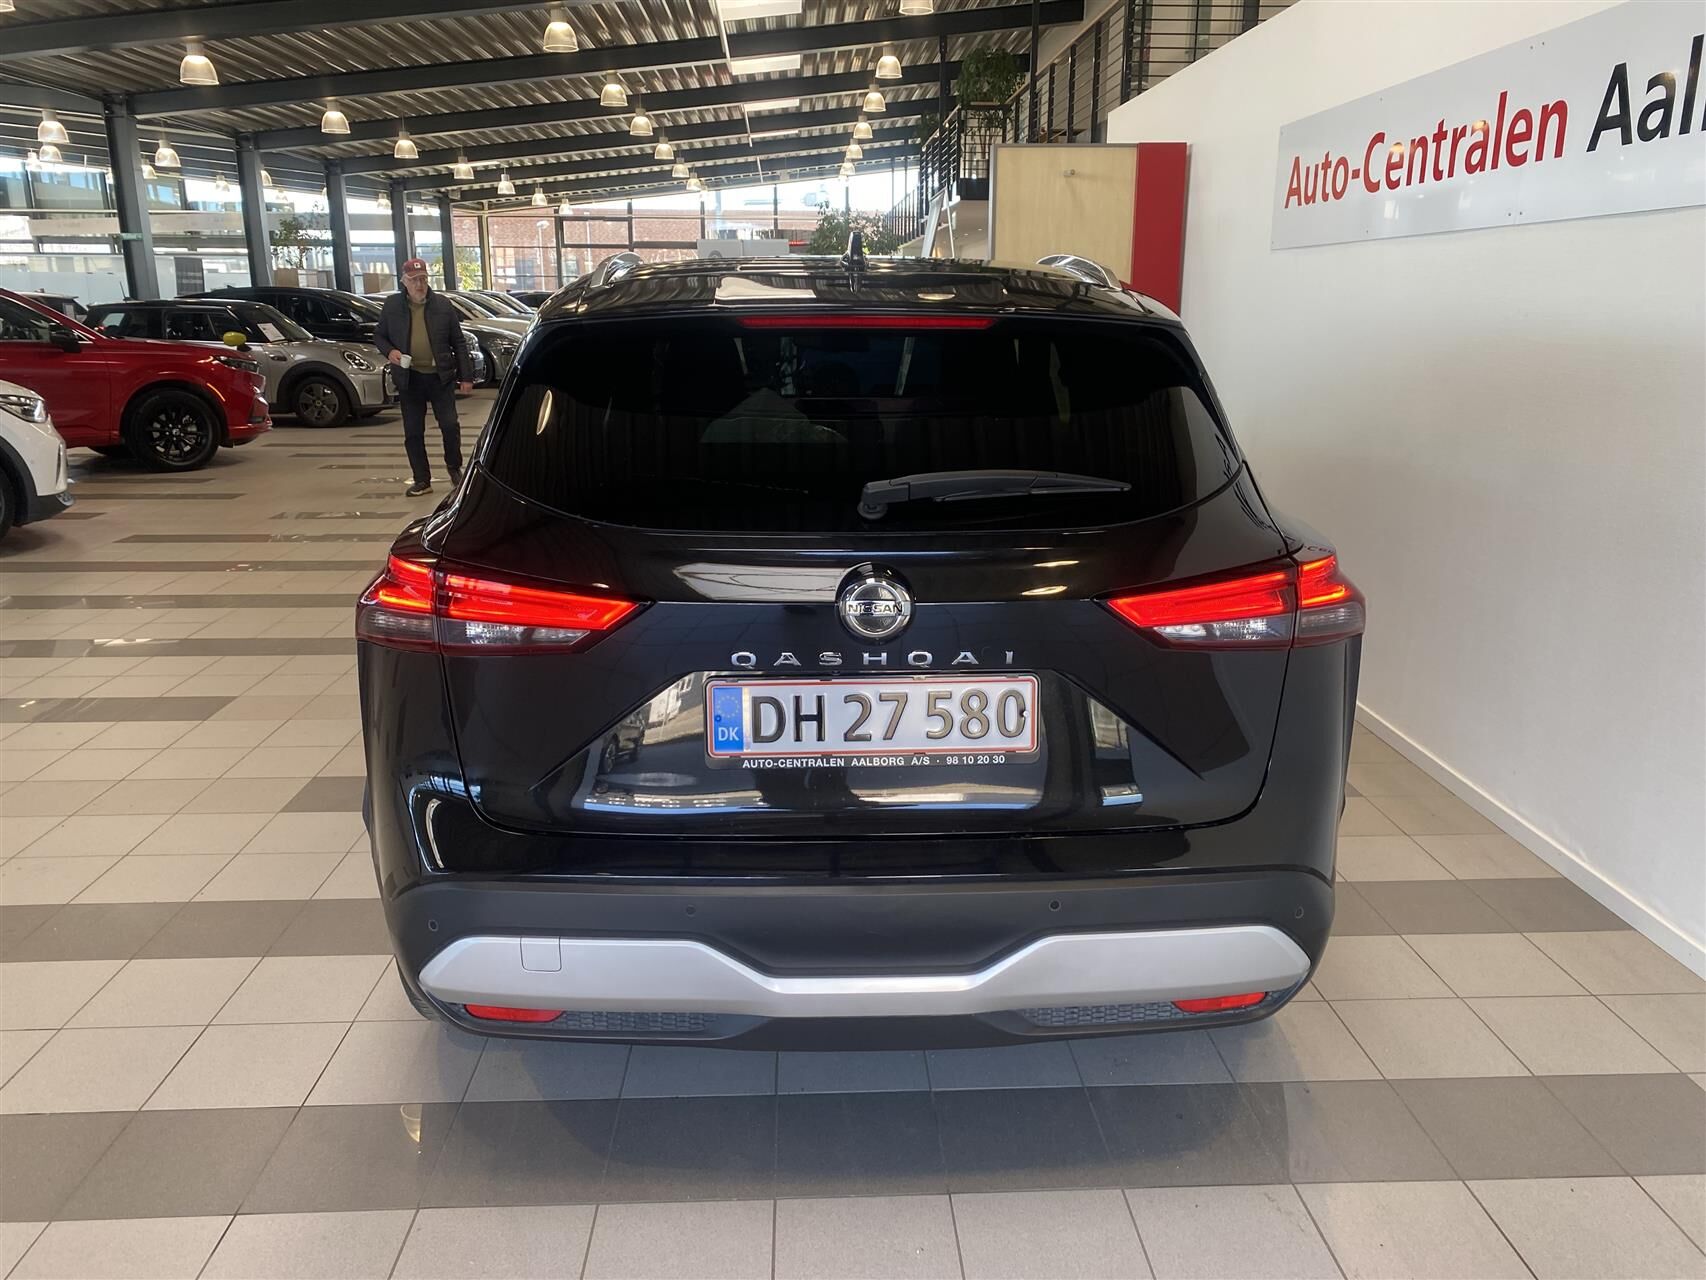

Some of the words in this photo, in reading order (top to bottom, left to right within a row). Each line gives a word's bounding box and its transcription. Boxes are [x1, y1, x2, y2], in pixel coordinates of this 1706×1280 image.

[1284, 90, 1569, 209] Auto-Centralen
[1586, 33, 1706, 153] Aal
[848, 603, 903, 613] NISSAN
[731, 651, 1014, 669] QASHQAI
[752, 695, 826, 744] DH
[843, 692, 909, 743] 27
[926, 688, 1026, 740] 580
[718, 726, 740, 741] DK
[742, 758, 845, 769] AUTO-CENTRALEN
[851, 757, 905, 767] AALBORG
[911, 756, 930, 766] A/S
[946, 756, 959, 765] 98
[962, 756, 974, 765] 10
[977, 755, 990, 764] 20
[992, 755, 1005, 764] 30
